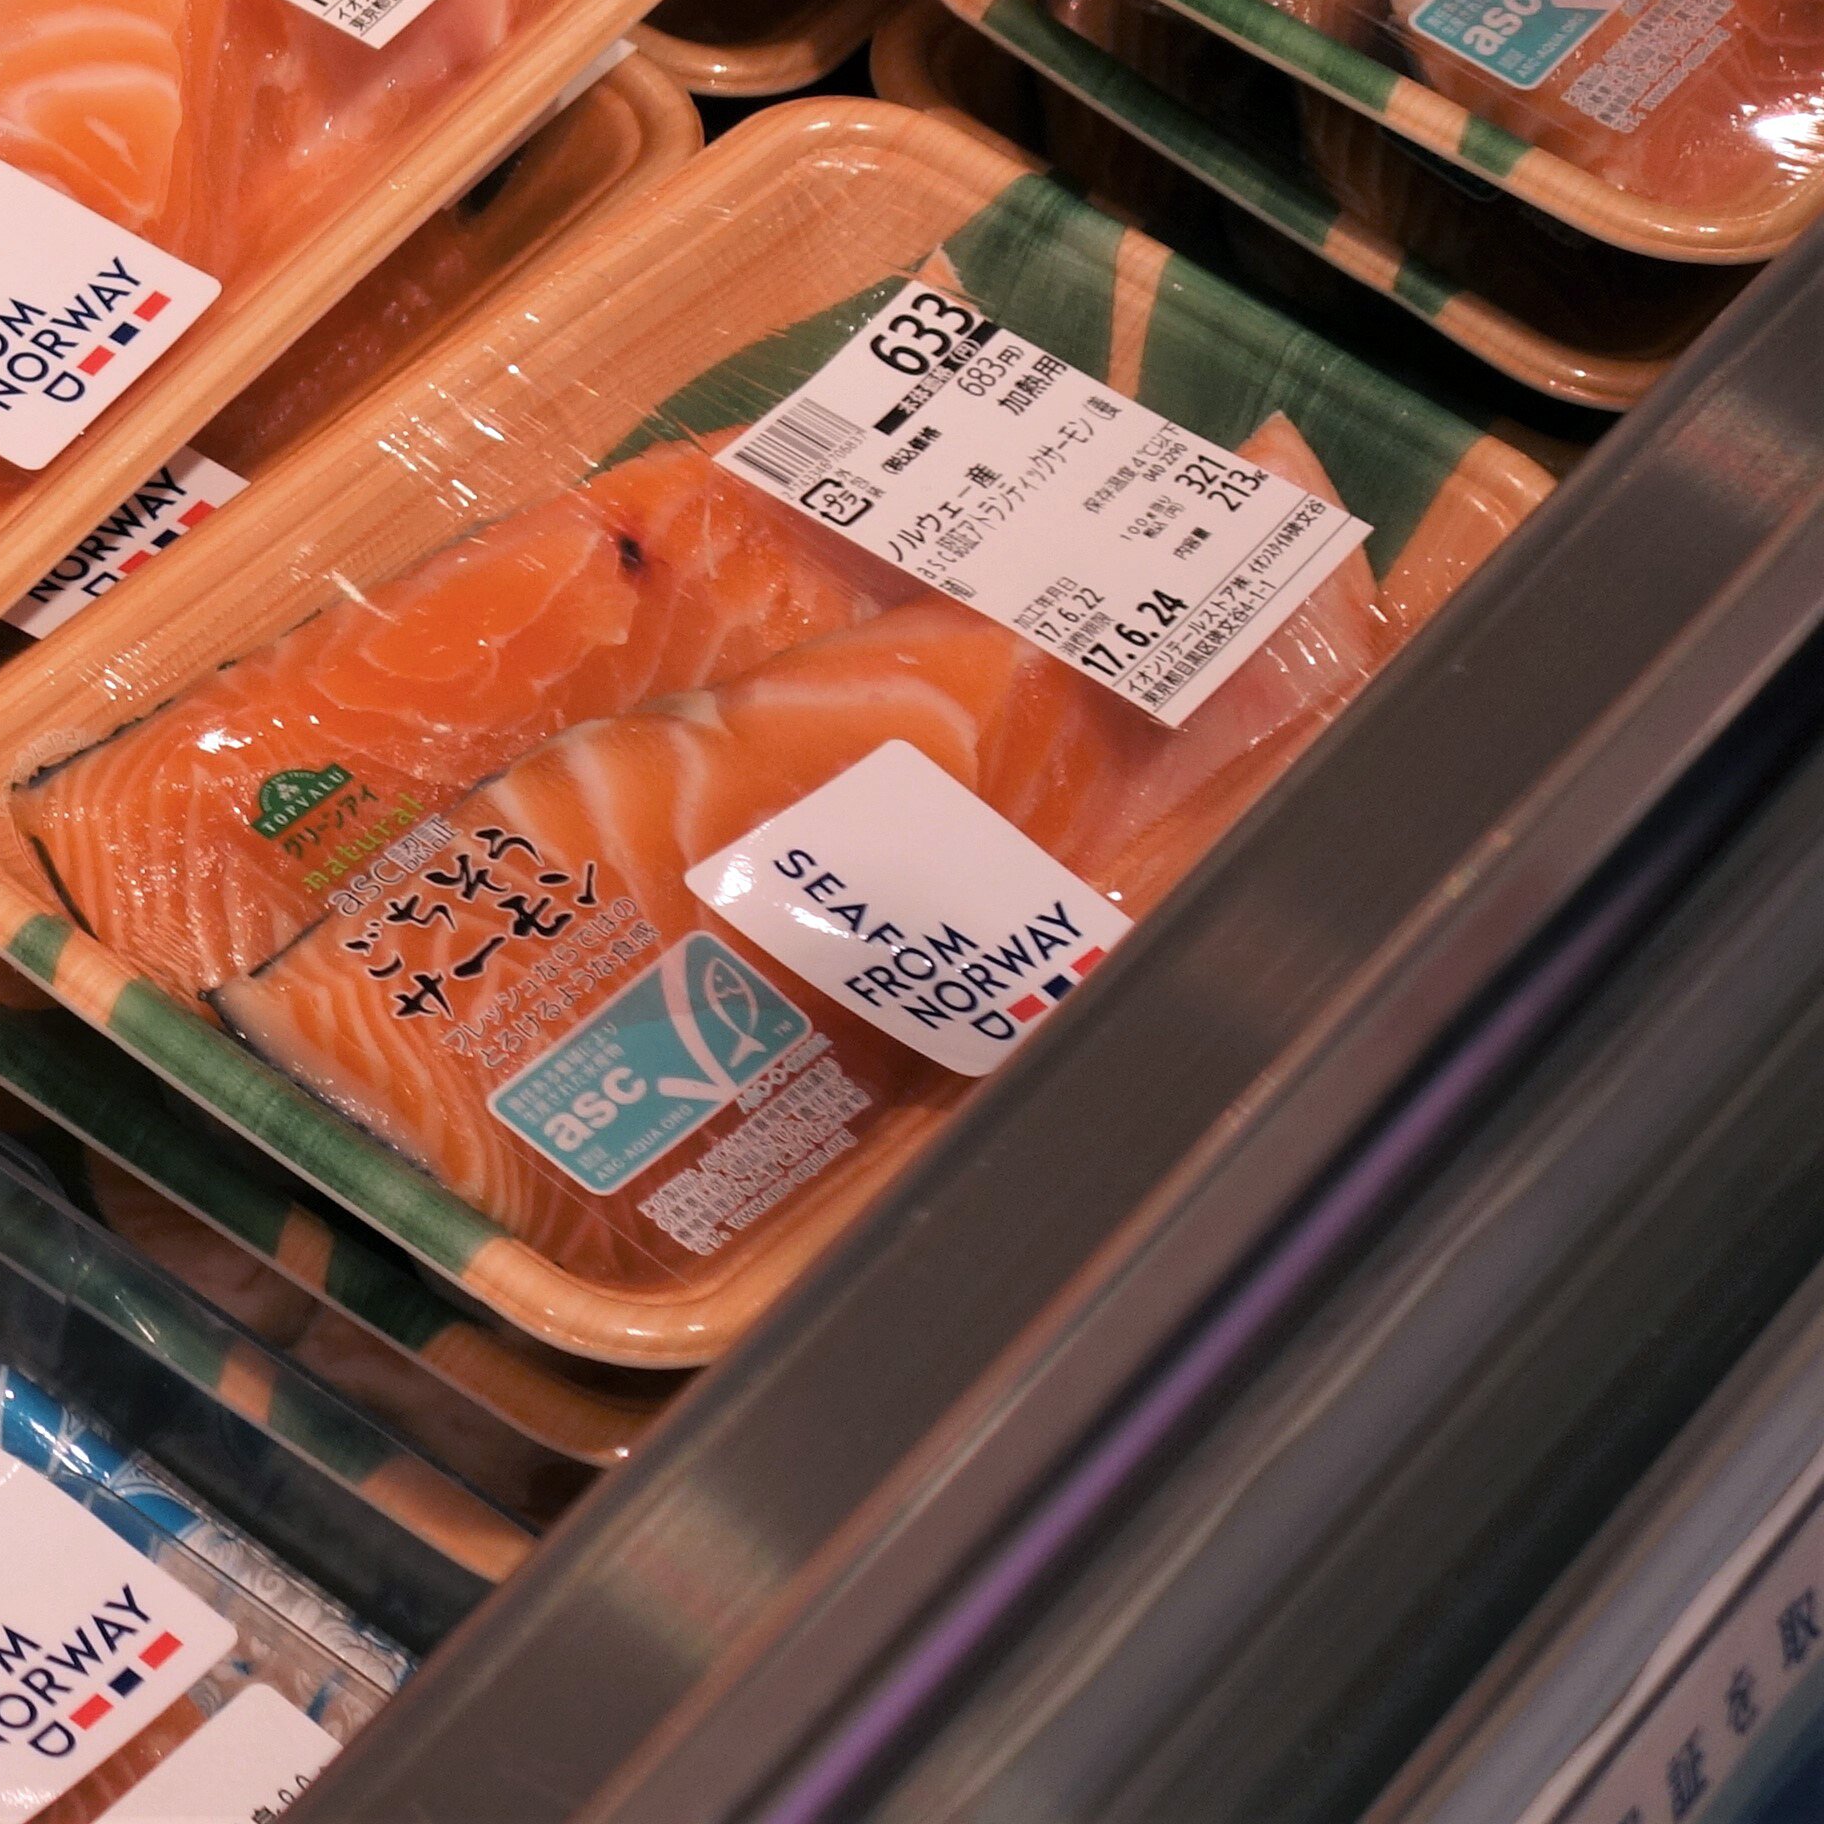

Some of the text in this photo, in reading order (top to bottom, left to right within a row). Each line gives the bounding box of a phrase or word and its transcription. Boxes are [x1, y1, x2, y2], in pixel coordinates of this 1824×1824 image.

[870, 293, 989, 376] 633
[998, 349, 1073, 415] 加熱用
[889, 464, 1002, 562] ノルウェー産
[345, 827, 544, 978] ごちそう
[394, 862, 599, 1020] サーモン
[845, 921, 973, 1010] FROM
[904, 902, 1084, 1030] NORWAY
[542, 1066, 646, 1151] asc
